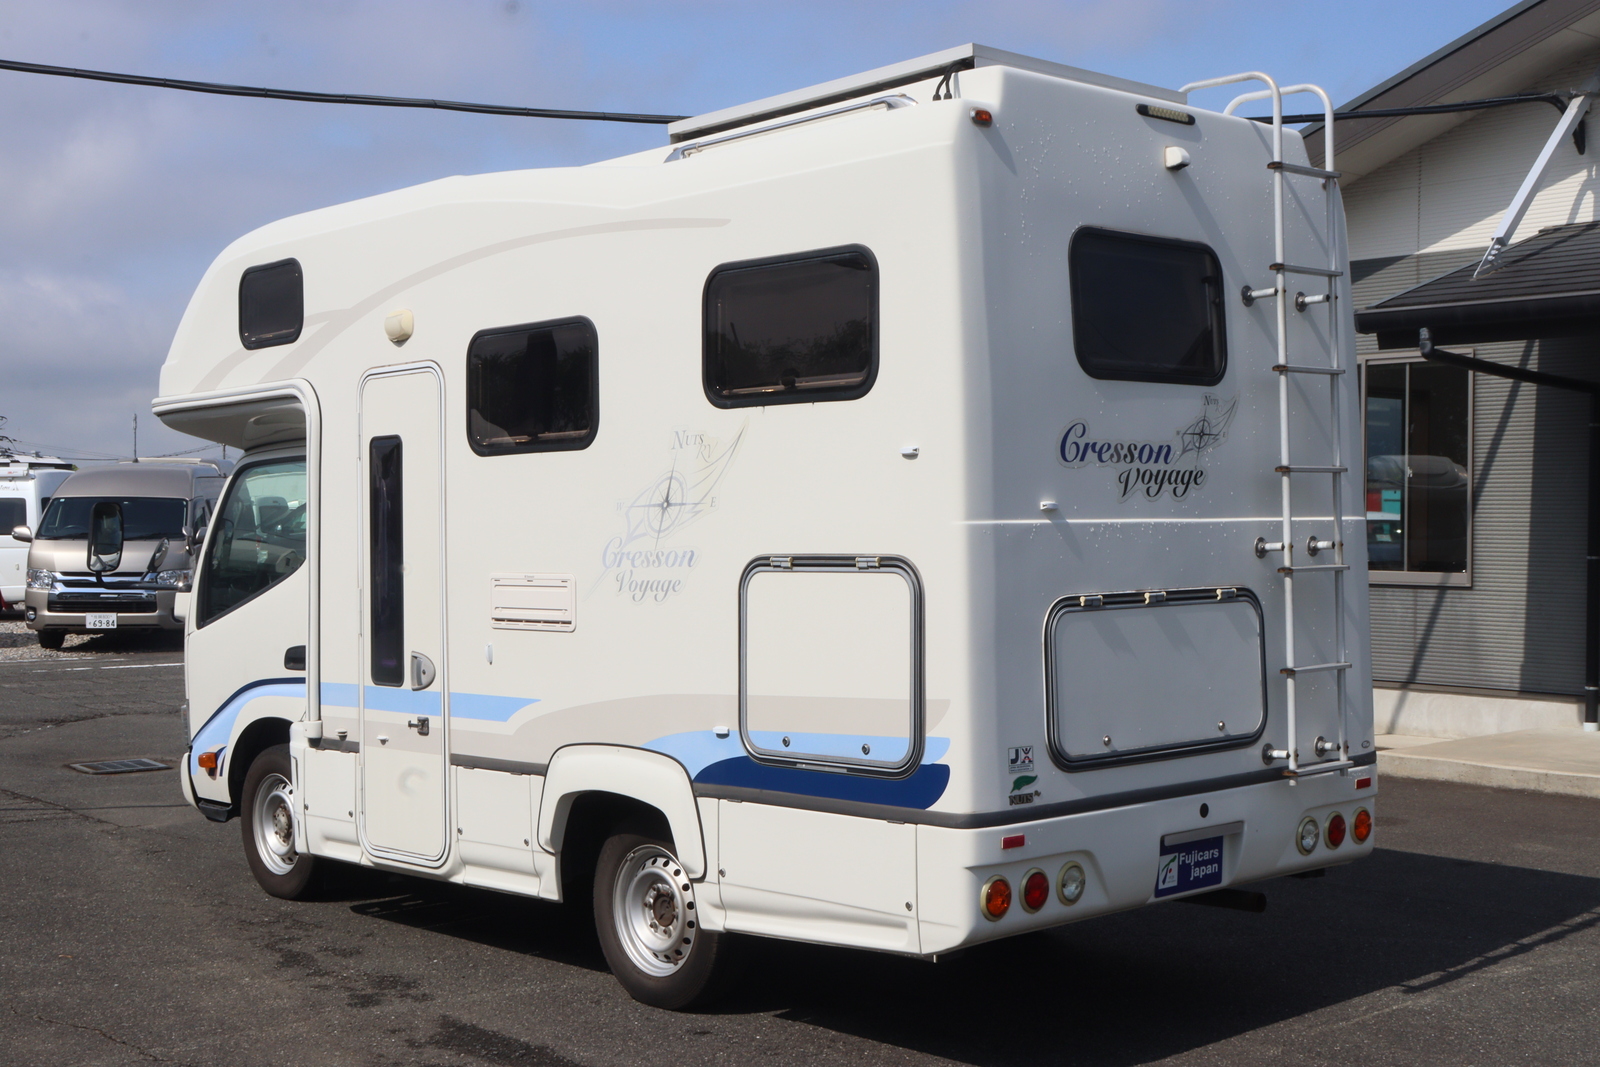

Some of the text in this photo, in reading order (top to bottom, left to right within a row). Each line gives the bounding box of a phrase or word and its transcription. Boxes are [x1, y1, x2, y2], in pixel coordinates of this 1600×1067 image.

[1060, 422, 1176, 465] Cresson
[1118, 466, 1206, 498] Voyage
[602, 536, 700, 569] Cresson
[616, 569, 682, 603] Voyage
[92, 619, 116, 628] 69-84
[1009, 793, 1034, 806] NUTS
[1179, 848, 1219, 866] Fujicars
[1190, 863, 1219, 881] japan
